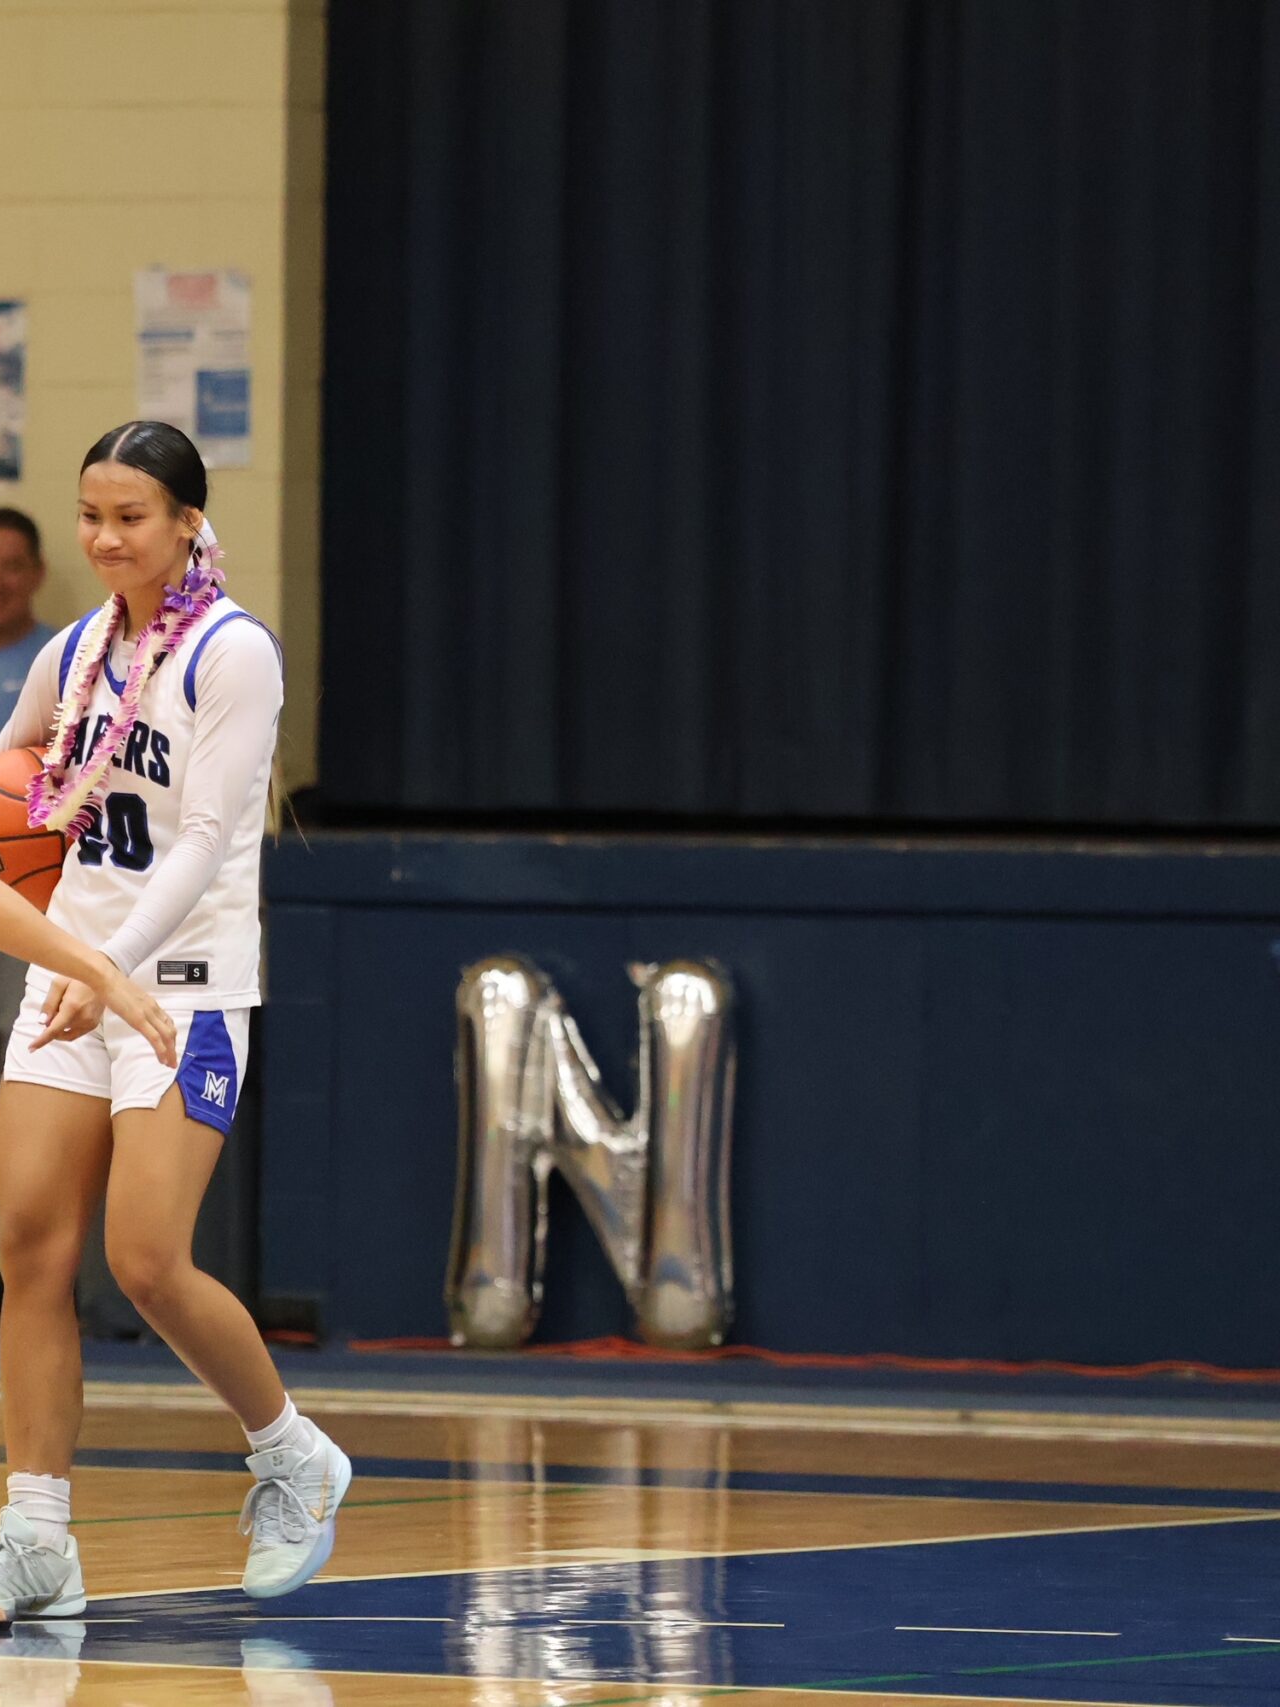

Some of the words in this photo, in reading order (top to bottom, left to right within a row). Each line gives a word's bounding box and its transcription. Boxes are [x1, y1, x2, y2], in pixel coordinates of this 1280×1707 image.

[192, 967, 201, 978] S
[200, 1070, 230, 1108] M
[445, 953, 736, 1352] N
